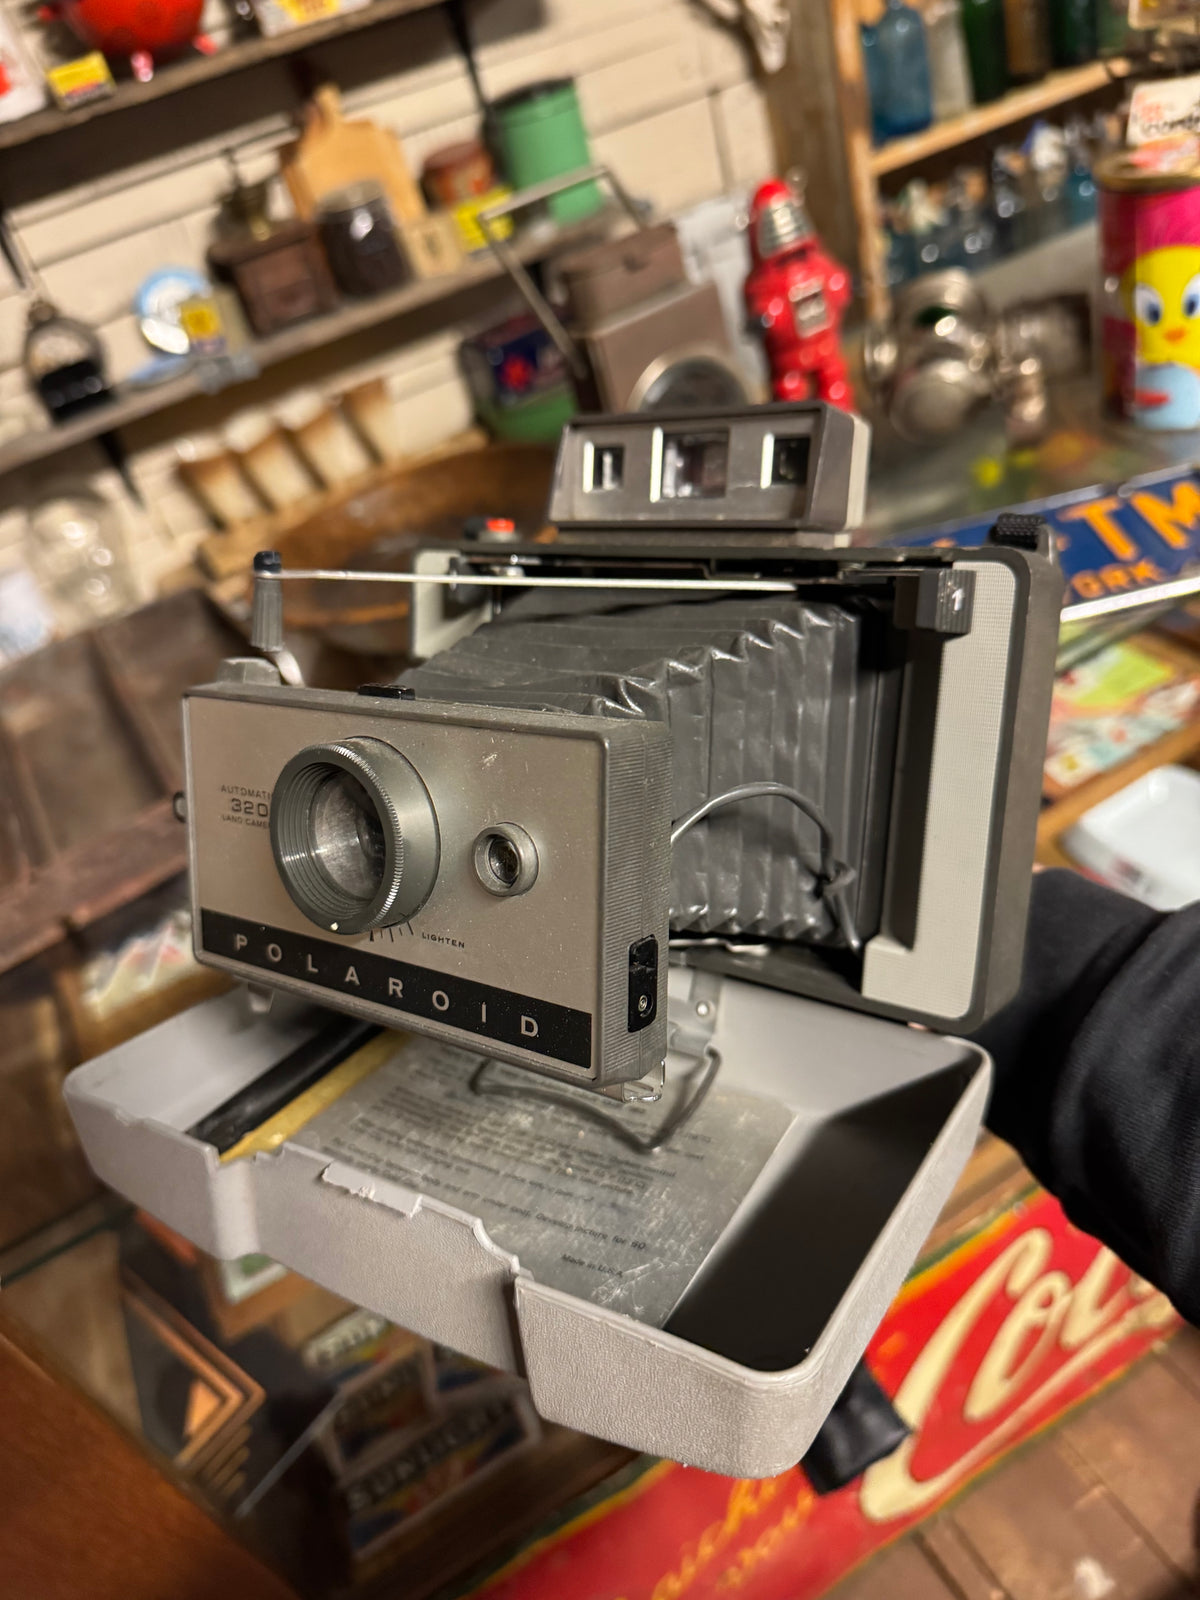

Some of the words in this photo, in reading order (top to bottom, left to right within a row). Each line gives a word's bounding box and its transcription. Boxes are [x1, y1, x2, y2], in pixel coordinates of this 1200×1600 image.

[220, 784, 271, 800] AUTOMATI
[231, 797, 268, 817] 320
[222, 814, 243, 824] LAND
[245, 818, 270, 829] CAME
[422, 932, 465, 949] LIGHTEN
[234, 933, 540, 1039] POLAROID
